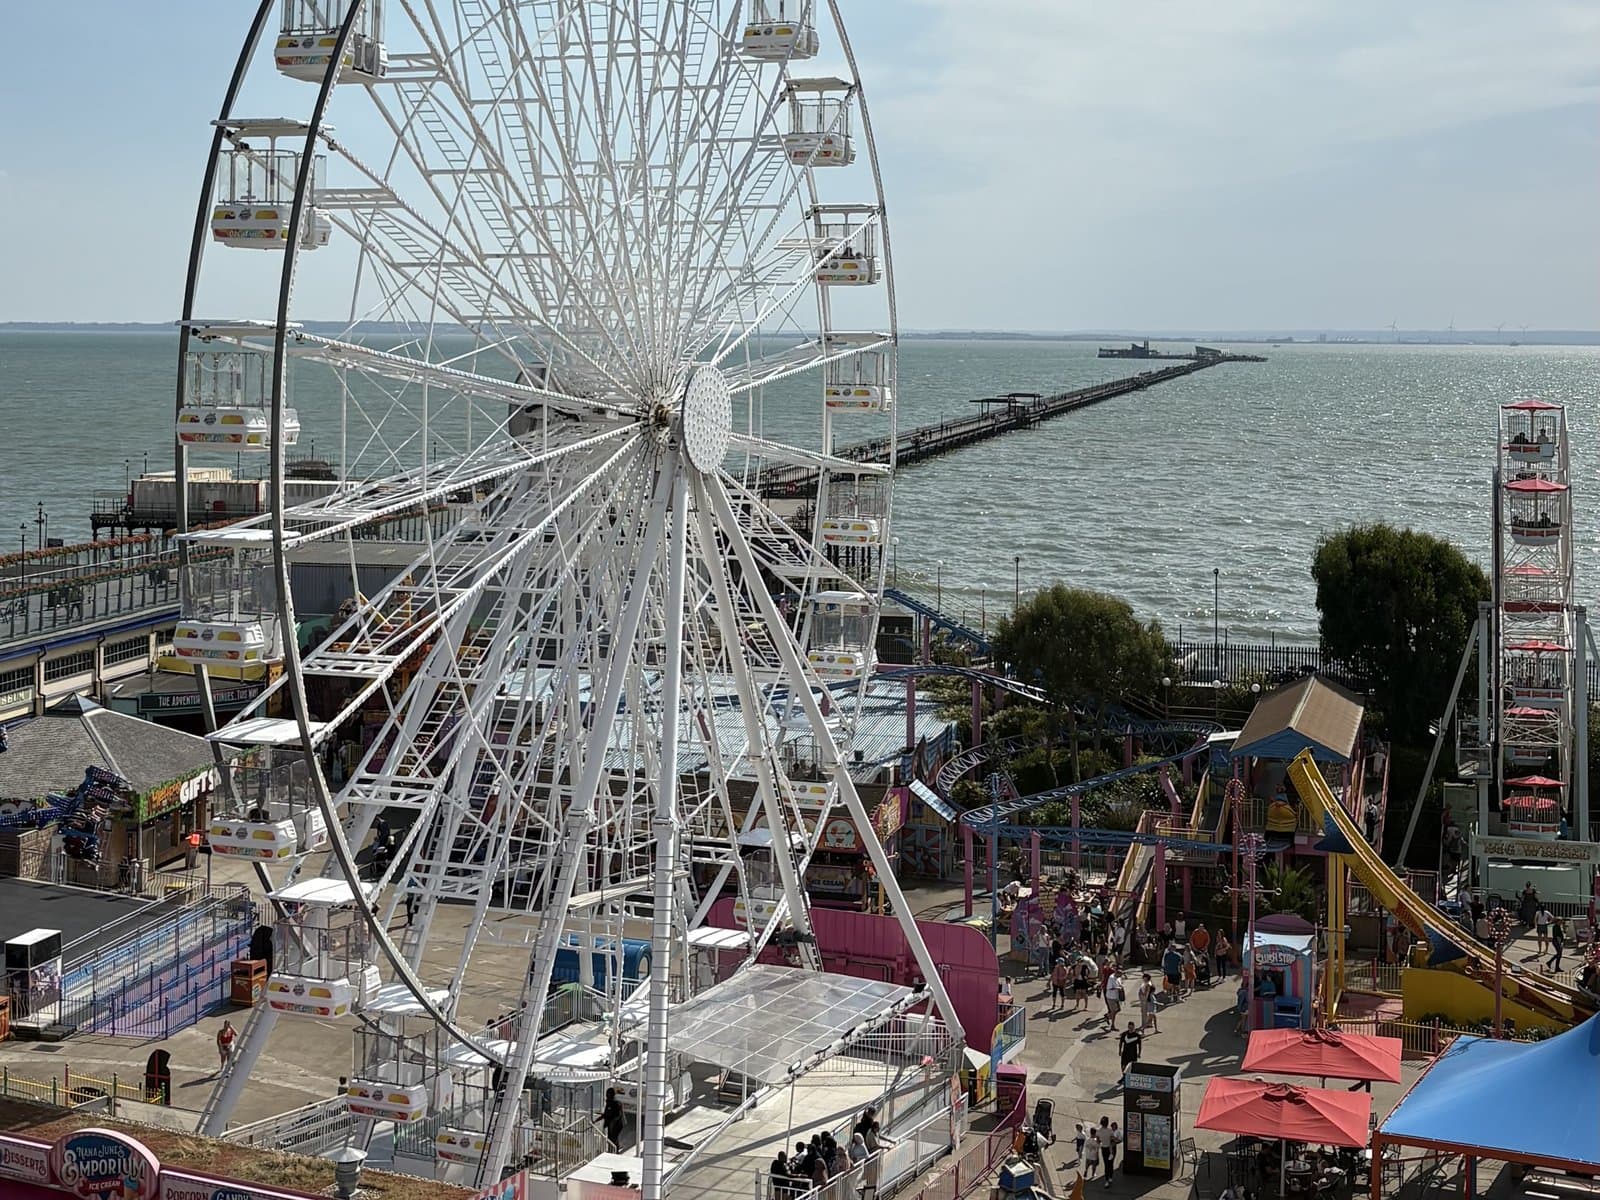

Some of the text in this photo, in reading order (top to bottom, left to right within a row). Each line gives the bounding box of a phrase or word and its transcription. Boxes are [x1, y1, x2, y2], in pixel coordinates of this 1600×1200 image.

[159, 696, 170, 707] THE
[172, 694, 201, 706] ADVENTUR
[3, 1148, 46, 1176] DESSERTS
[60, 1149, 146, 1186] EMPORIUM
[88, 1180, 121, 1190] ICE CREAM
